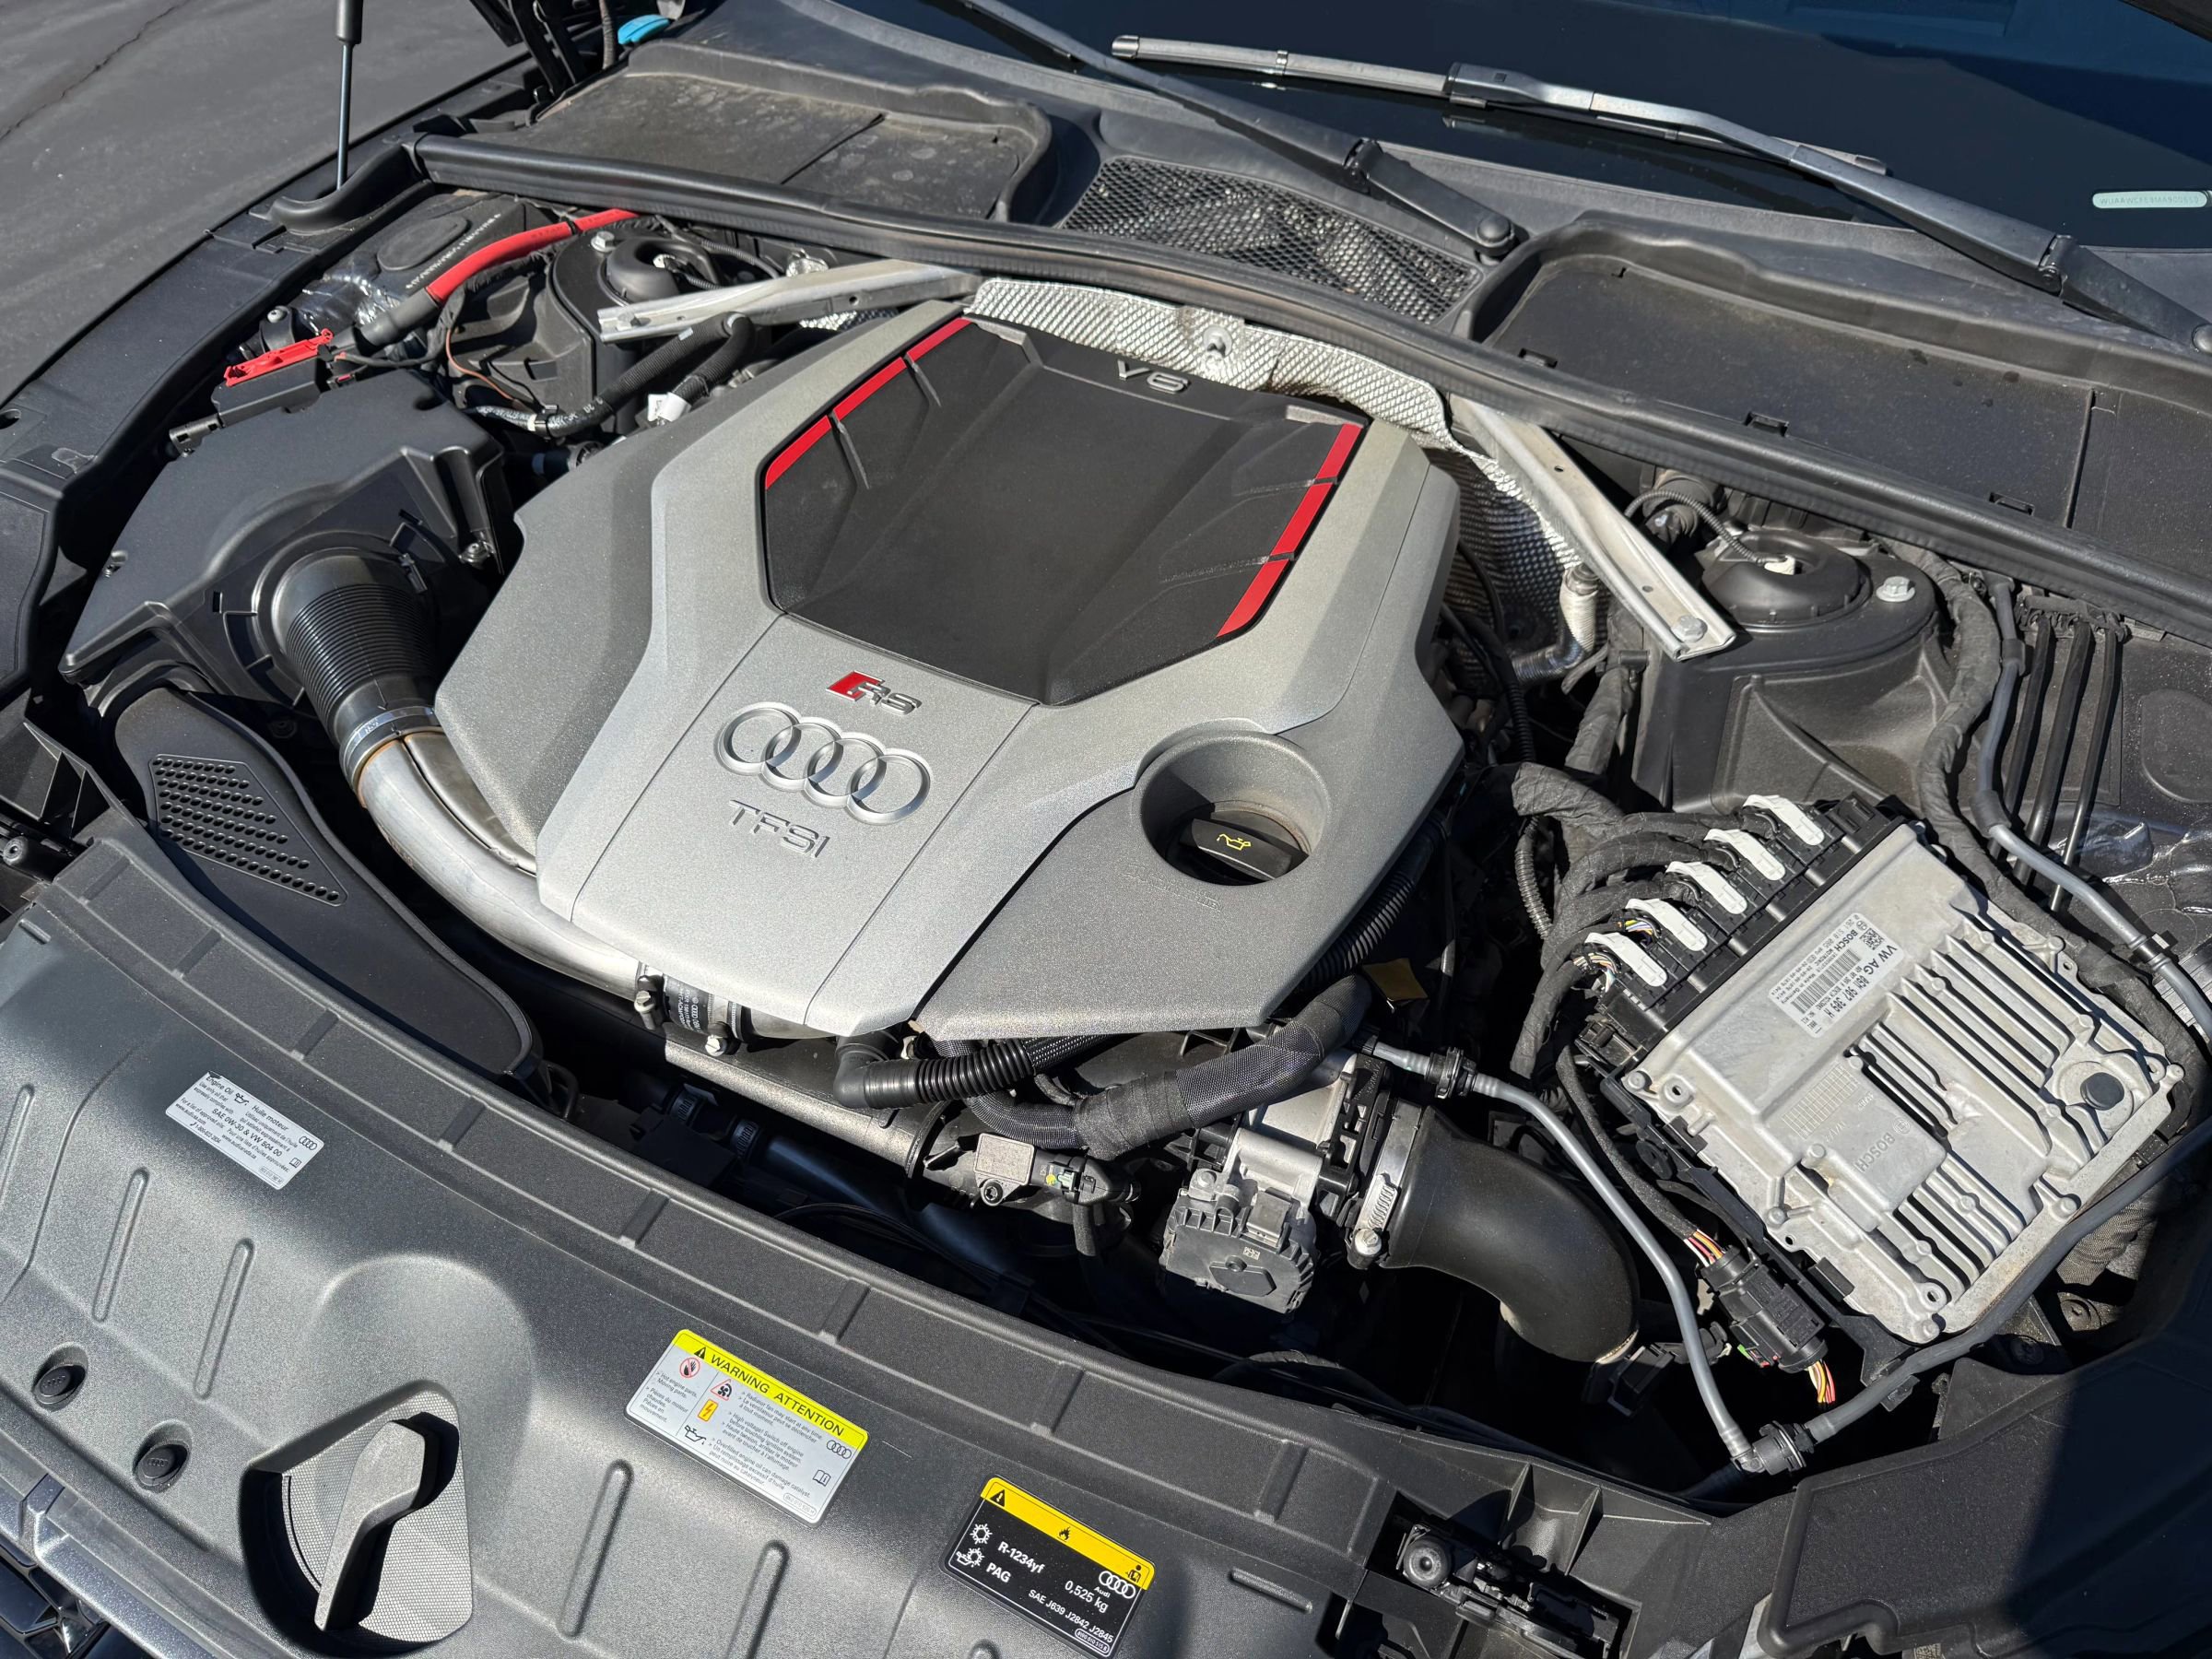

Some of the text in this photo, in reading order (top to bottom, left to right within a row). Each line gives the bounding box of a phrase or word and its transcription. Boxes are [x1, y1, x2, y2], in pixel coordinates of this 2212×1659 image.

[1117, 359, 1188, 394] V6
[828, 672, 923, 716] RS
[729, 800, 830, 857] TFSI
[1834, 929, 1857, 951] BOSCH
[1862, 943, 1896, 975] VW AG
[1781, 987, 1799, 1005] Germany
[1830, 997, 1845, 1011] 309
[1841, 986, 1857, 1000] 907
[1824, 1008, 1833, 1018] H
[205, 1076, 226, 1089] Engine
[251, 1104, 288, 1130] Huile moteur
[211, 1108, 226, 1118] SAE
[223, 1116, 244, 1131] 0W-30
[249, 1133, 262, 1143] VW
[261, 1140, 274, 1150] 504
[272, 1148, 283, 1157] 00
[226, 1127, 238, 1136] Pour
[1854, 1132, 1895, 1172] BOSCH
[656, 1378, 675, 1392] Moving
[660, 1372, 669, 1381] Hot
[668, 1378, 685, 1390] engine
[671, 1400, 688, 1413] moteur
[710, 1354, 844, 1435] WARNING ATTENTION
[748, 1402, 773, 1418] ventilateur
[773, 1416, 784, 1425] peut
[773, 1409, 783, 1418] may
[784, 1415, 795, 1424] start
[722, 1429, 735, 1439] avant
[742, 1441, 760, 1453] toucher
[725, 1423, 740, 1434] Haute
[780, 1454, 797, 1467] moteur
[729, 1418, 745, 1430] before
[744, 1428, 765, 1442] touching
[764, 1440, 783, 1453] ignition
[732, 1413, 744, 1423] High
[763, 1430, 780, 1442] Switch
[786, 1445, 804, 1457] engine
[709, 1450, 720, 1459] peut
[720, 1456, 733, 1466] nuire
[712, 1443, 721, 1452] Un
[720, 1449, 748, 1469] remplissage
[748, 1465, 768, 1479] excessif
[715, 1439, 739, 1455] Overfilled
[737, 1453, 755, 1465] engine
[770, 1472, 791, 1487] damage
[997, 1541, 1045, 1574] R-1234yf
[986, 1562, 1011, 1583] PAG
[1064, 1580, 1109, 1613] 0,525 kg
[1093, 1585, 1111, 1598] Audi
[1028, 1589, 1113, 1642] SAE J639 J2842 J2845
